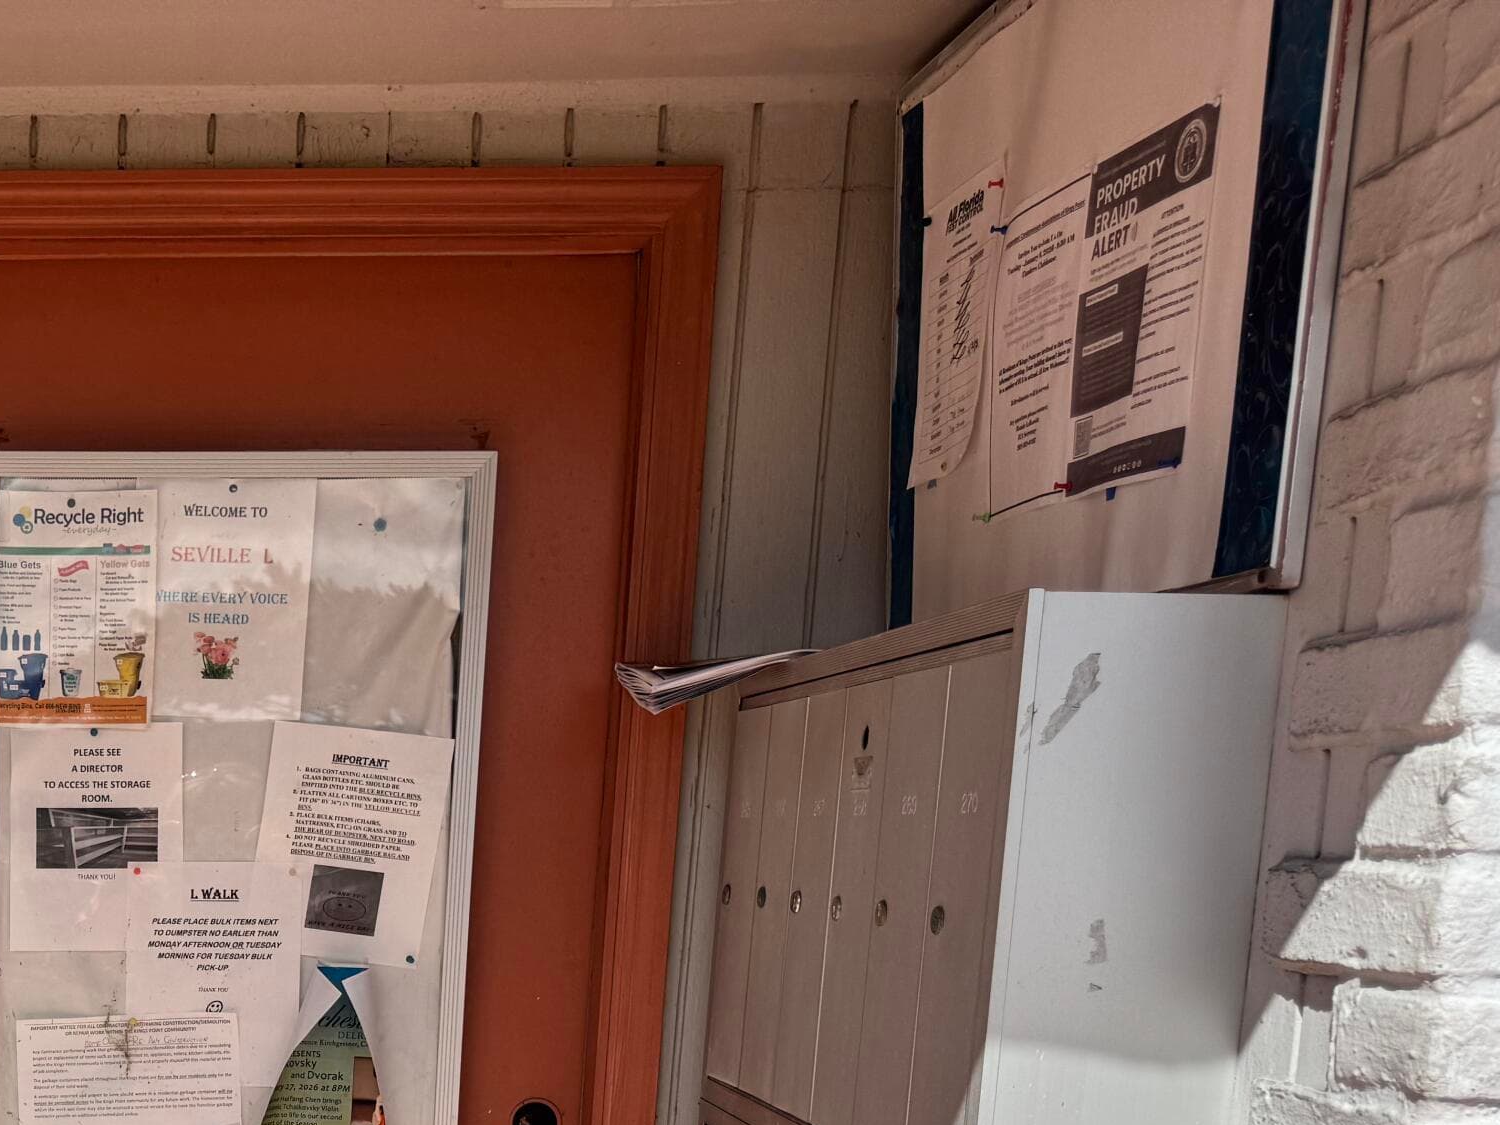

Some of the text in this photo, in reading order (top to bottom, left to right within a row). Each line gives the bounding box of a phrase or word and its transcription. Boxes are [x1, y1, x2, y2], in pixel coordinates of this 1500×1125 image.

[1096, 154, 1166, 208] PROPERTY
[958, 188, 984, 217] Florida
[1094, 198, 1138, 235] FRAUD
[184, 504, 268, 518] WELCOME TO
[34, 507, 144, 527] Recycle Right
[171, 545, 274, 564] SEVILLE L
[21, 561, 41, 569] Gets
[100, 560, 150, 568] Yellow Gets
[202, 591, 247, 605] EVERY
[250, 592, 288, 605] VOICE
[188, 612, 249, 625] IS HEARD
[73, 748, 121, 757] PLEASE SEE
[332, 754, 390, 769] IMPORTANT
[71, 764, 123, 773] A DIRECTOR
[322, 769, 360, 777] CONTAINING
[362, 773, 396, 782] ALUMINUM
[44, 781, 151, 789] TO ACCESS THE STORAGE
[365, 780, 391, 788] SHOULD
[300, 789, 327, 797] FLATTEN
[301, 781, 328, 789] EMPTIED
[377, 789, 405, 798] RECYCLE
[81, 794, 113, 803] ROOM.
[960, 792, 979, 815] 270
[202, 887, 239, 900] WALK
[152, 918, 279, 926] PLEASE PLACE BULK ITEMS NEXT
[154, 929, 279, 937] TO DUMPSTER NO EARLIER THAN
[148, 941, 282, 949] MONDAY AFTERNOON OR TUESDAY
[158, 952, 272, 960] MORNING FOR TUESDAY BULK
[338, 1031, 366, 1040] DELR
[291, 1050, 321, 1058] ESENTS
[308, 1071, 344, 1080] Dvorak
[331, 1084, 351, 1092] 8PM
